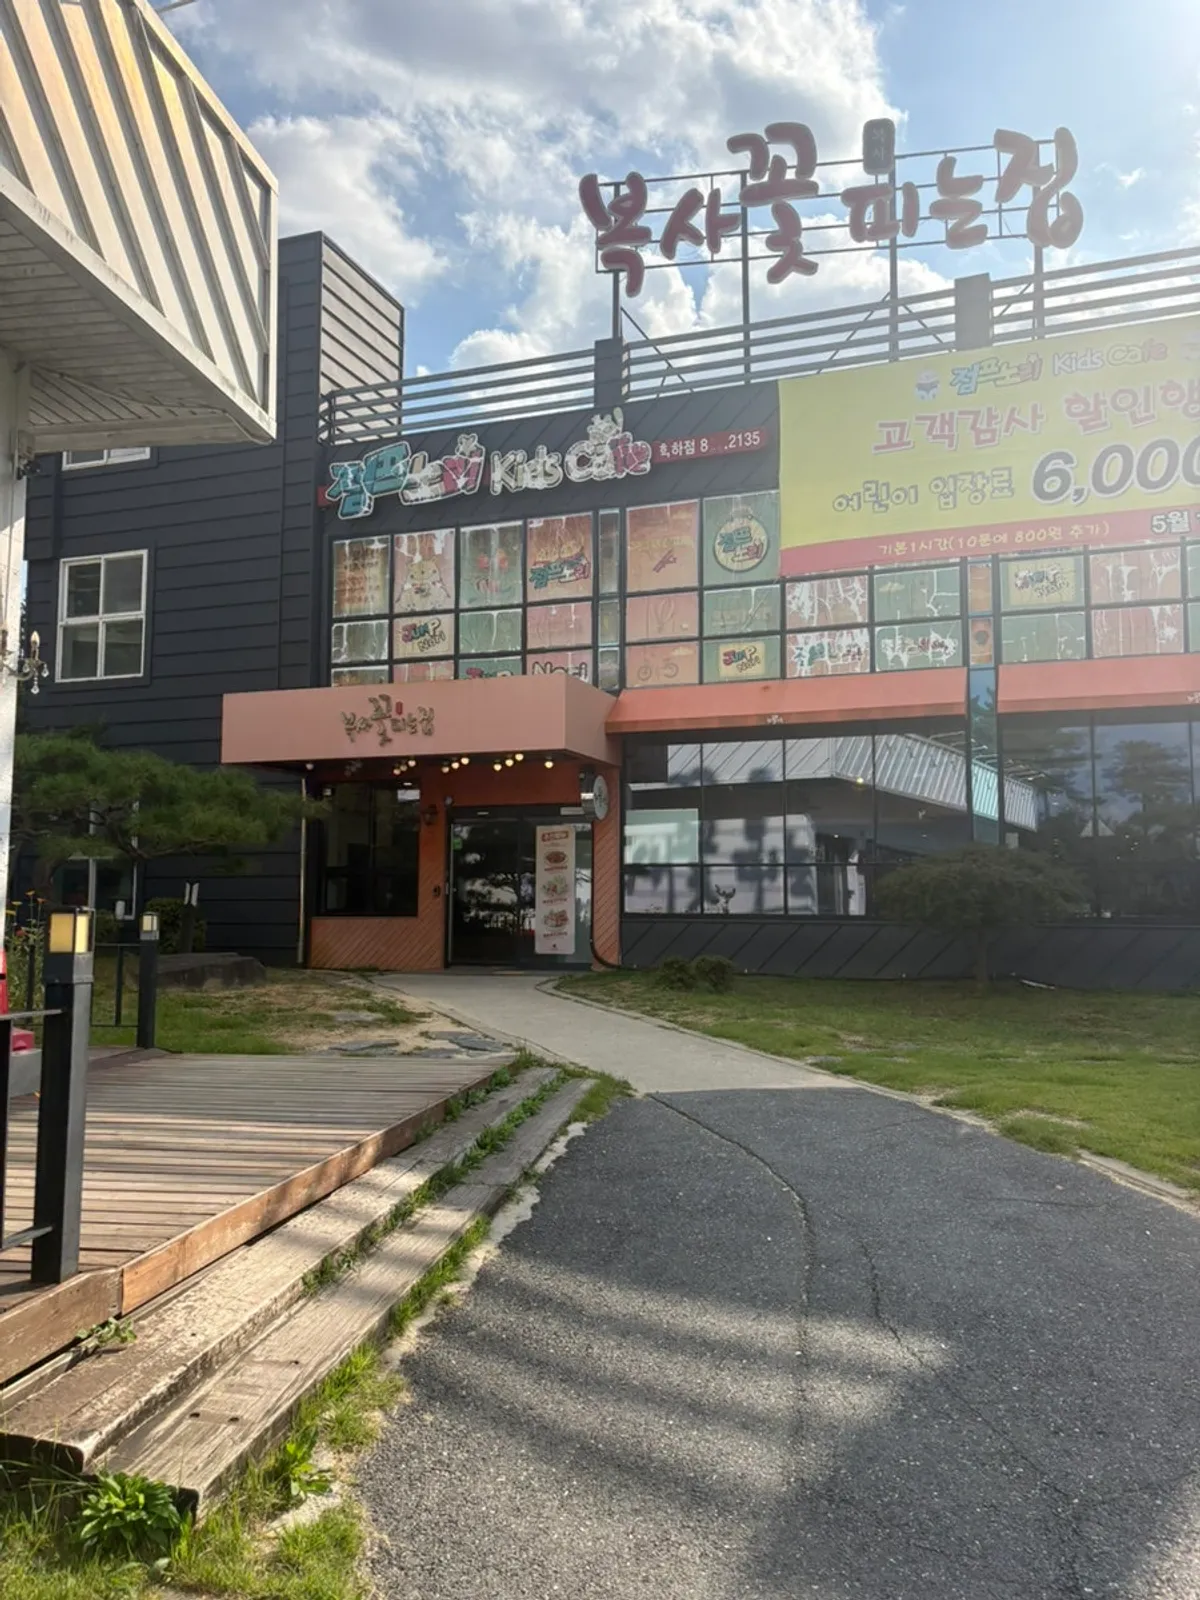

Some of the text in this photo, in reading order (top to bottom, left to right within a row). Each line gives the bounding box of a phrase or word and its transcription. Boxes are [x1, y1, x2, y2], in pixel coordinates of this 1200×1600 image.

[950, 338, 1169, 395] 점프노리 Kids Cafe
[872, 402, 1046, 454] 고객감사
[490, 445, 564, 495] Kids
[832, 479, 918, 513] 어린이
[929, 466, 1014, 510] 입장료
[1014, 525, 1063, 544] 800원
[1151, 510, 1191, 534] 5월
